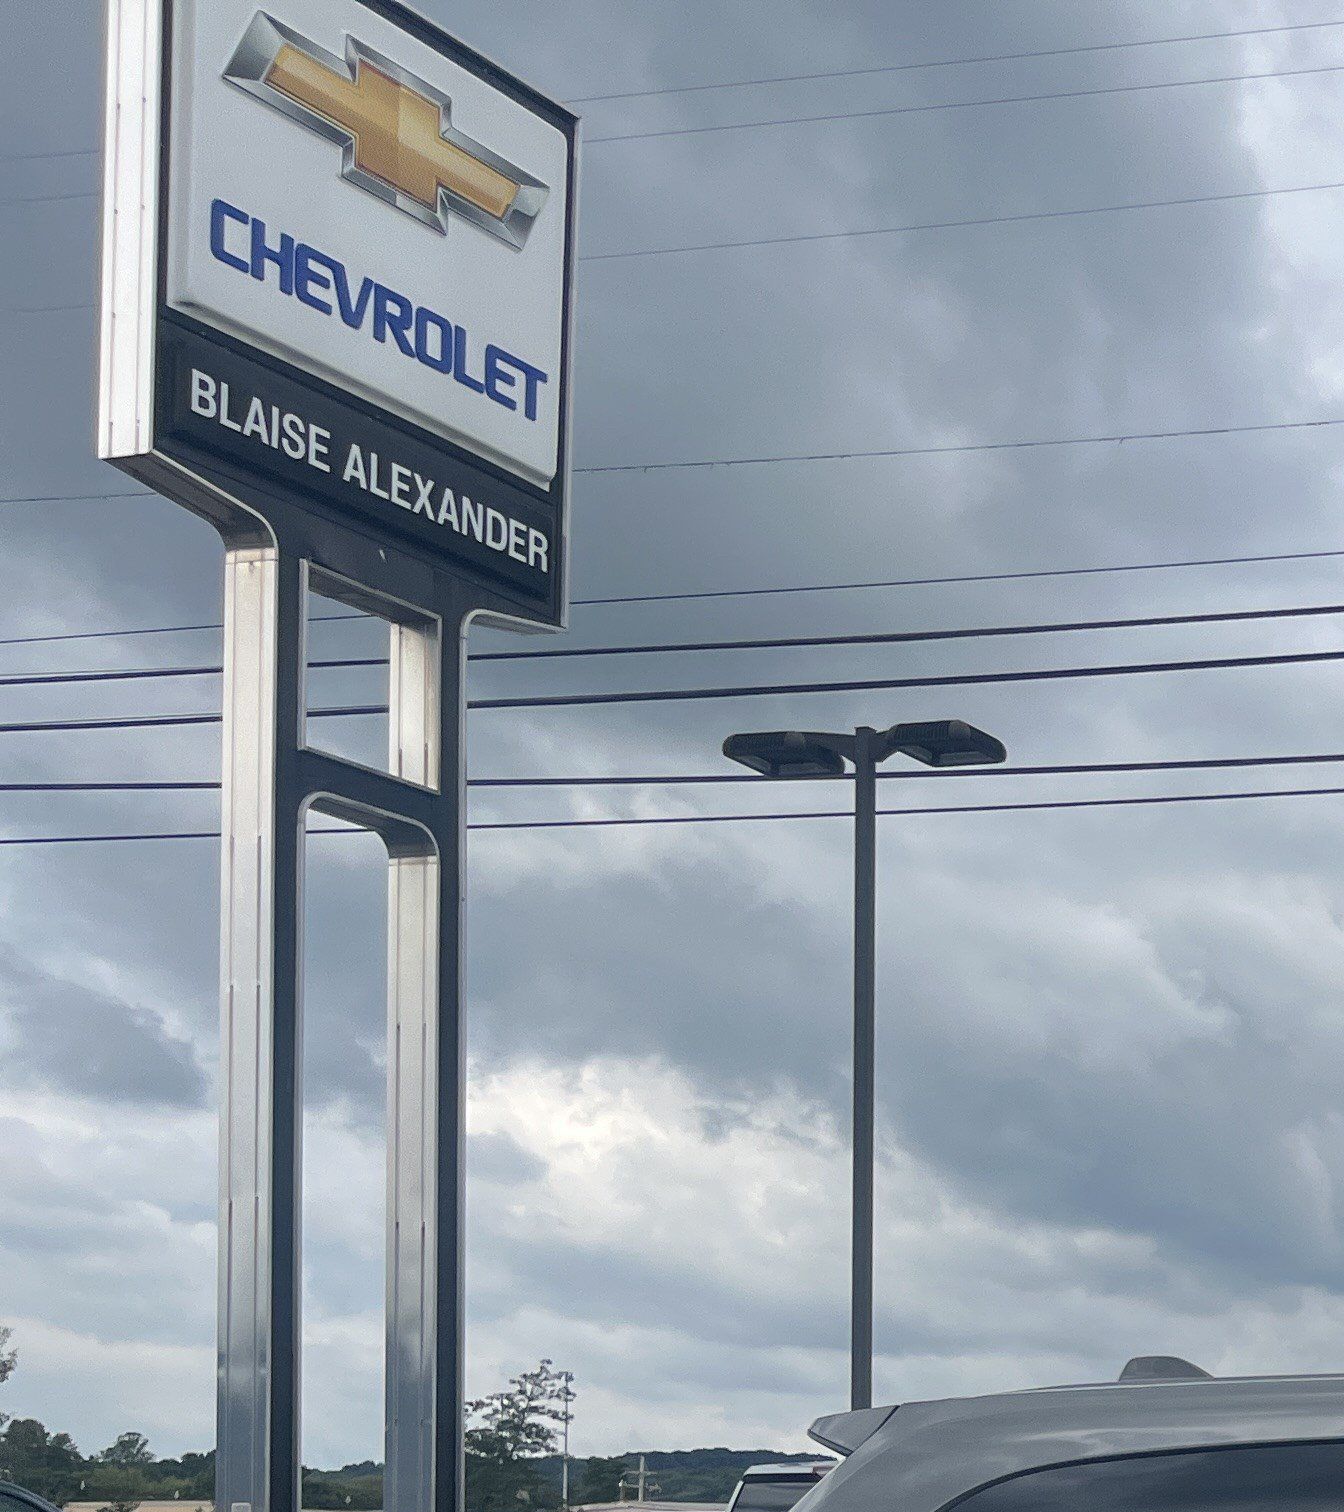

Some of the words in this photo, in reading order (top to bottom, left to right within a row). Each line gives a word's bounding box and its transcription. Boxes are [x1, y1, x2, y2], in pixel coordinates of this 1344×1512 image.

[210, 198, 548, 422] CHEVROLET
[190, 369, 331, 474] BLAISE
[342, 443, 549, 574] ALEXANDER
